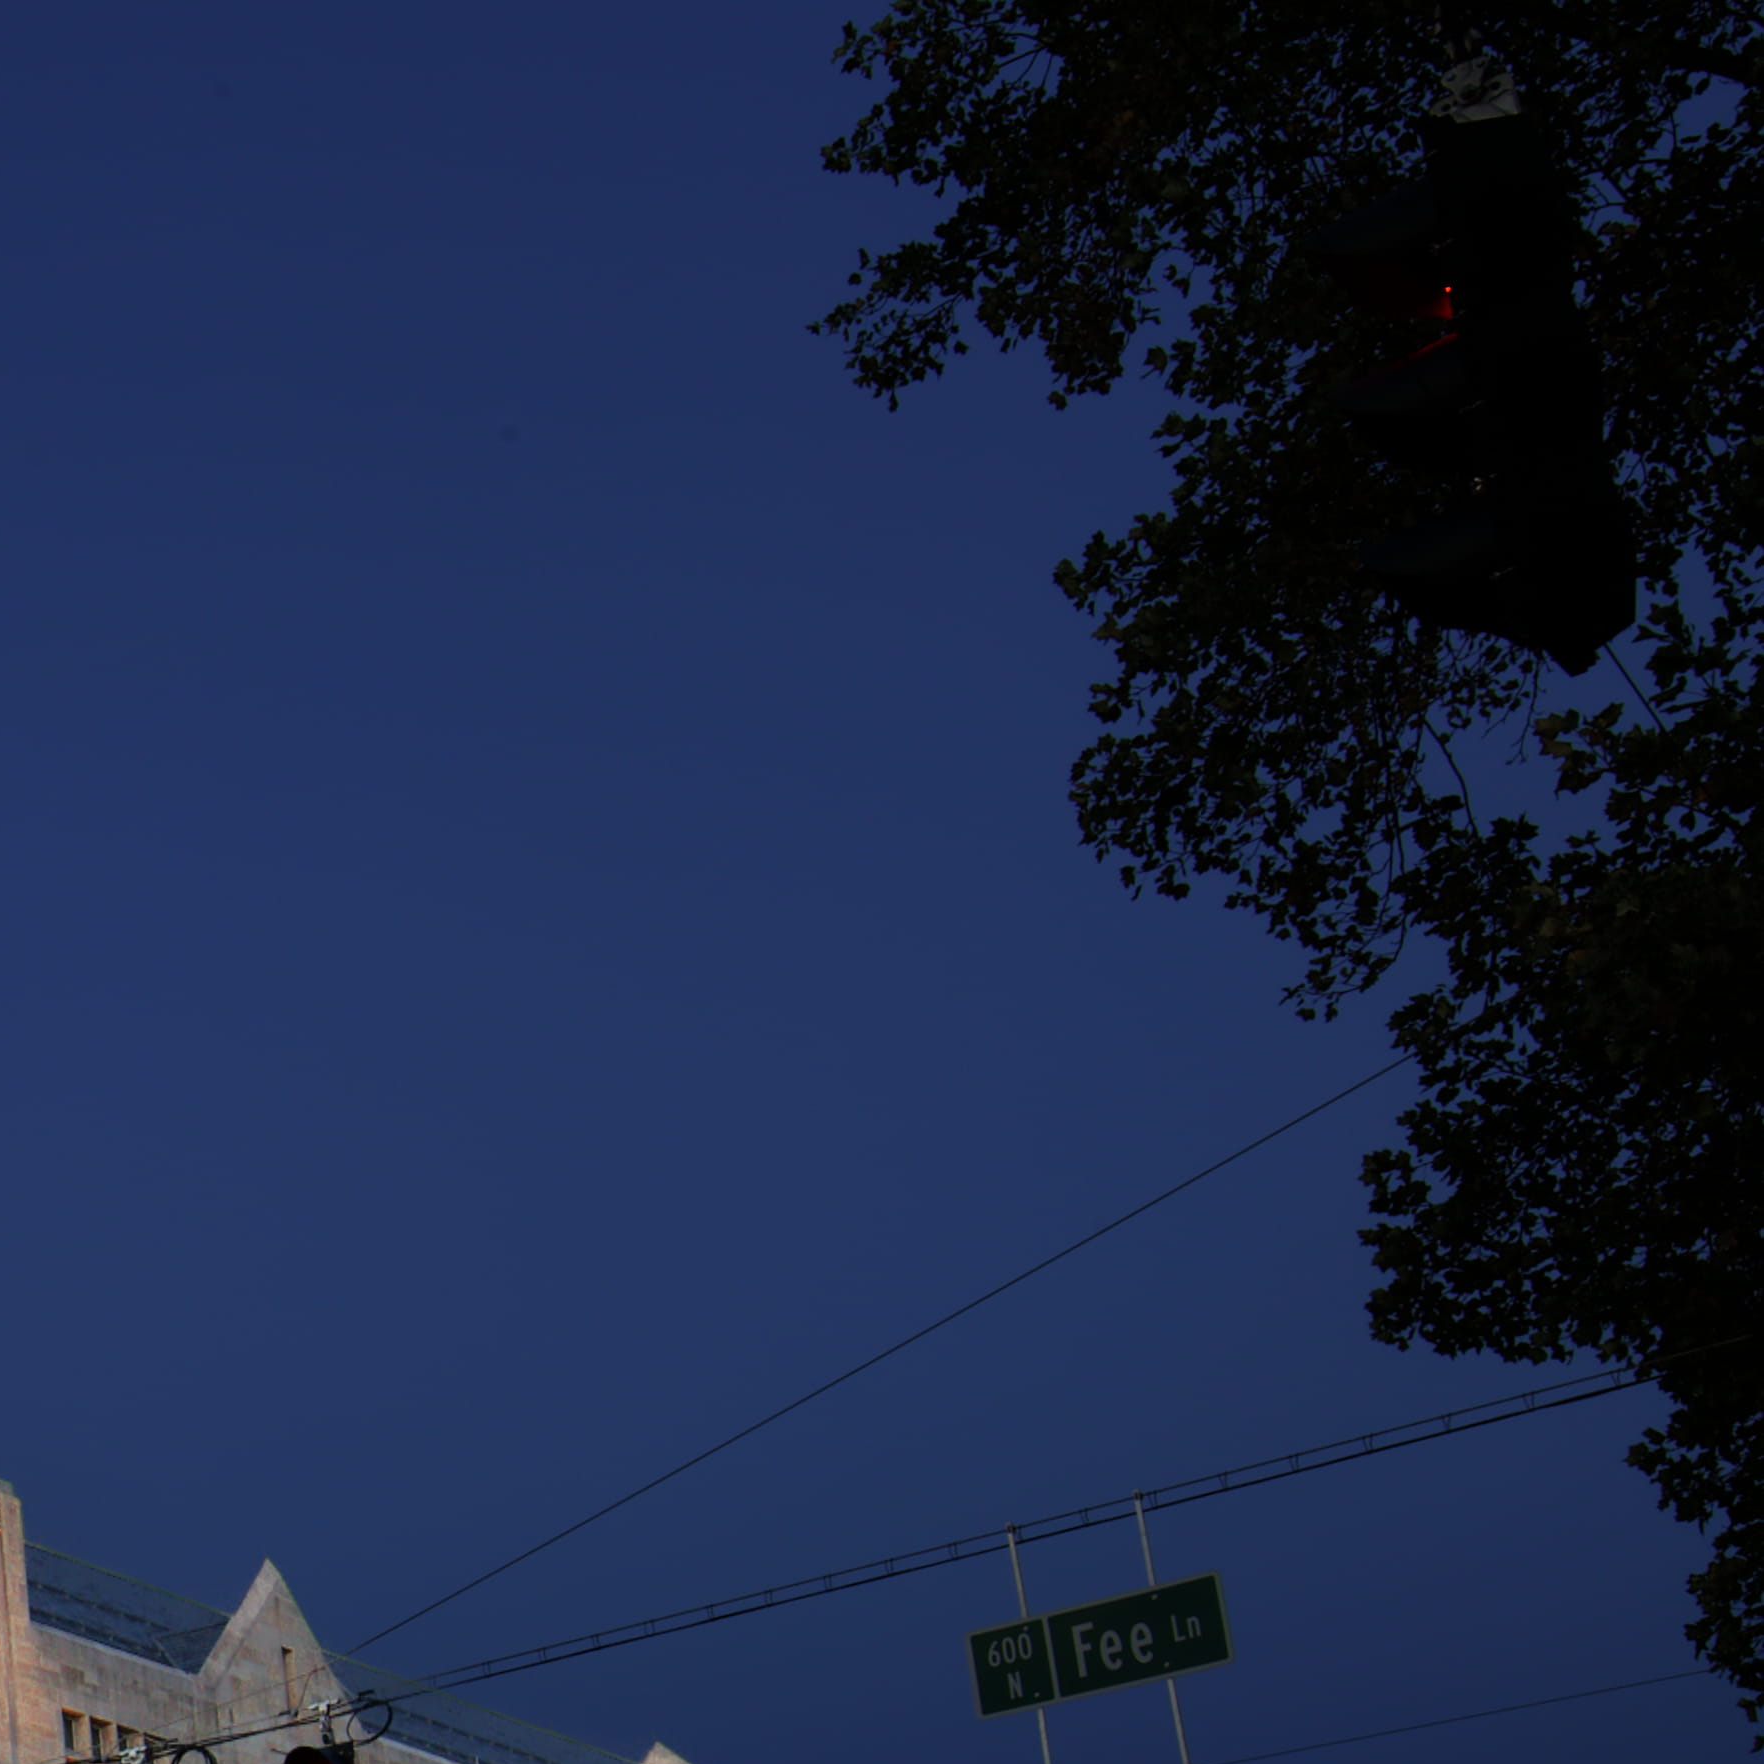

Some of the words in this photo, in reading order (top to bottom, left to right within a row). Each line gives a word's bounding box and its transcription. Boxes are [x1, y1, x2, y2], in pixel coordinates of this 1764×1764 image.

[987, 1632, 1033, 1668] 600
[1071, 1621, 1154, 1679] Fee
[1171, 1612, 1202, 1644] Ln
[1007, 1671, 1024, 1700] N
